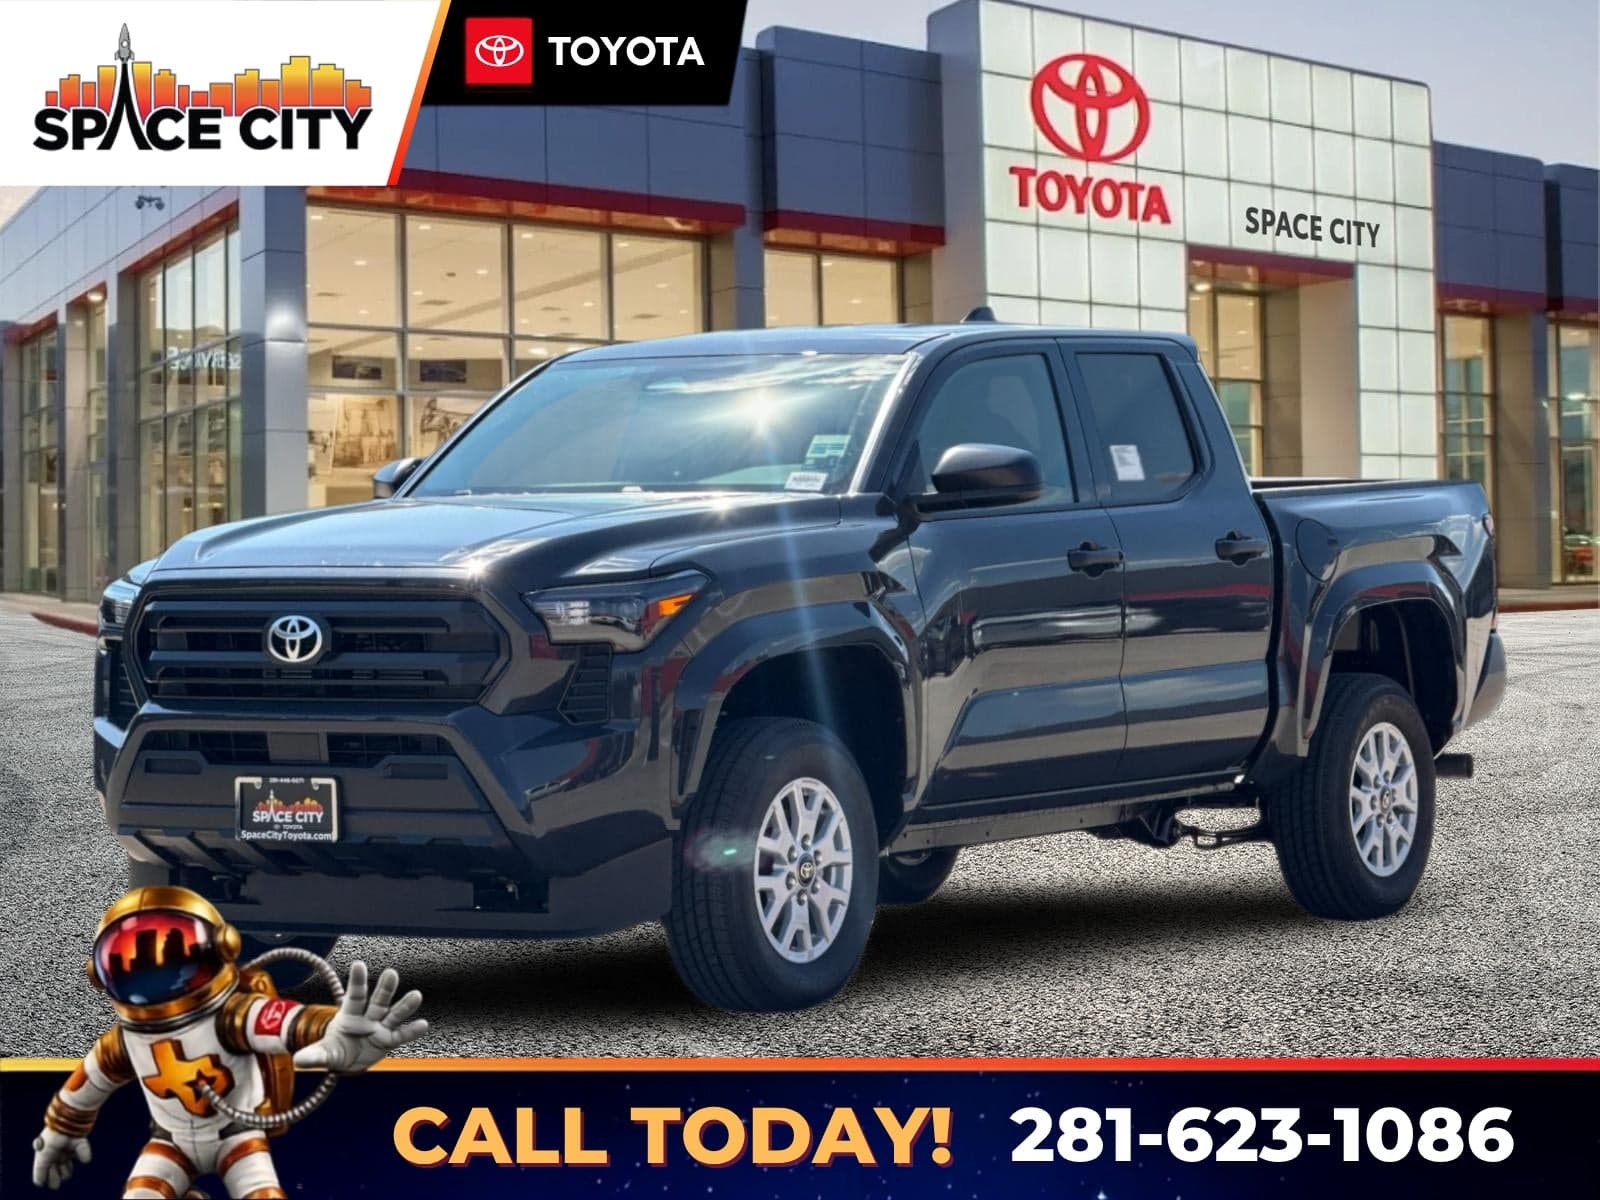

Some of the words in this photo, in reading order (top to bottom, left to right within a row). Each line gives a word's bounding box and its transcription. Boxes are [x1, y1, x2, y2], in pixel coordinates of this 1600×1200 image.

[1009, 166, 1171, 225] TOYOTA
[1245, 206, 1323, 242] SPACE
[1329, 217, 1381, 248] CITY
[252, 808, 292, 823] SPACE
[295, 810, 324, 823] CITY
[241, 830, 332, 841] SpaceCityToyota.com
